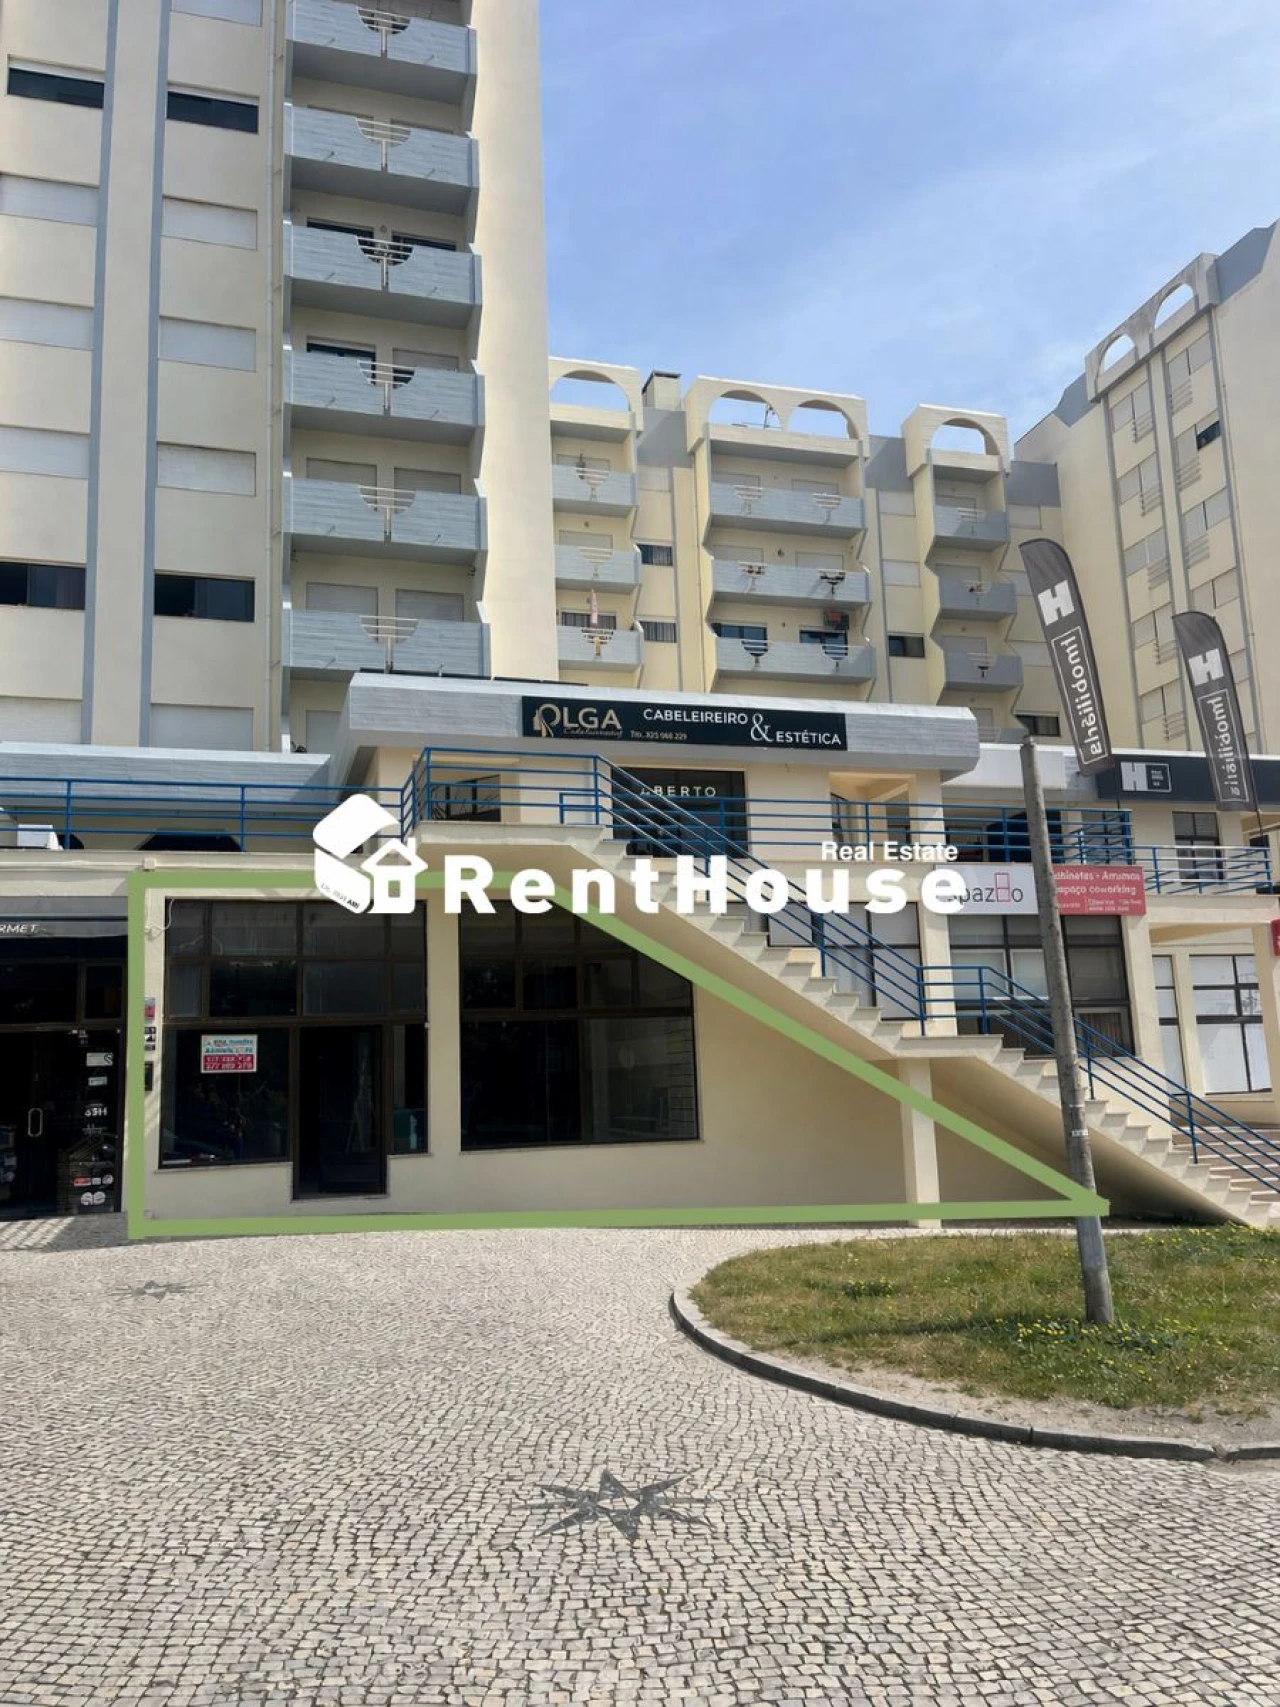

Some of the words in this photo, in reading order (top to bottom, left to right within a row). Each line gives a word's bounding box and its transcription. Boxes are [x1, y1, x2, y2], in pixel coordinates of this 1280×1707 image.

[643, 707, 749, 725] CABELEIREIRO
[750, 713, 774, 743] &
[775, 729, 842, 745] ESTÉTICA
